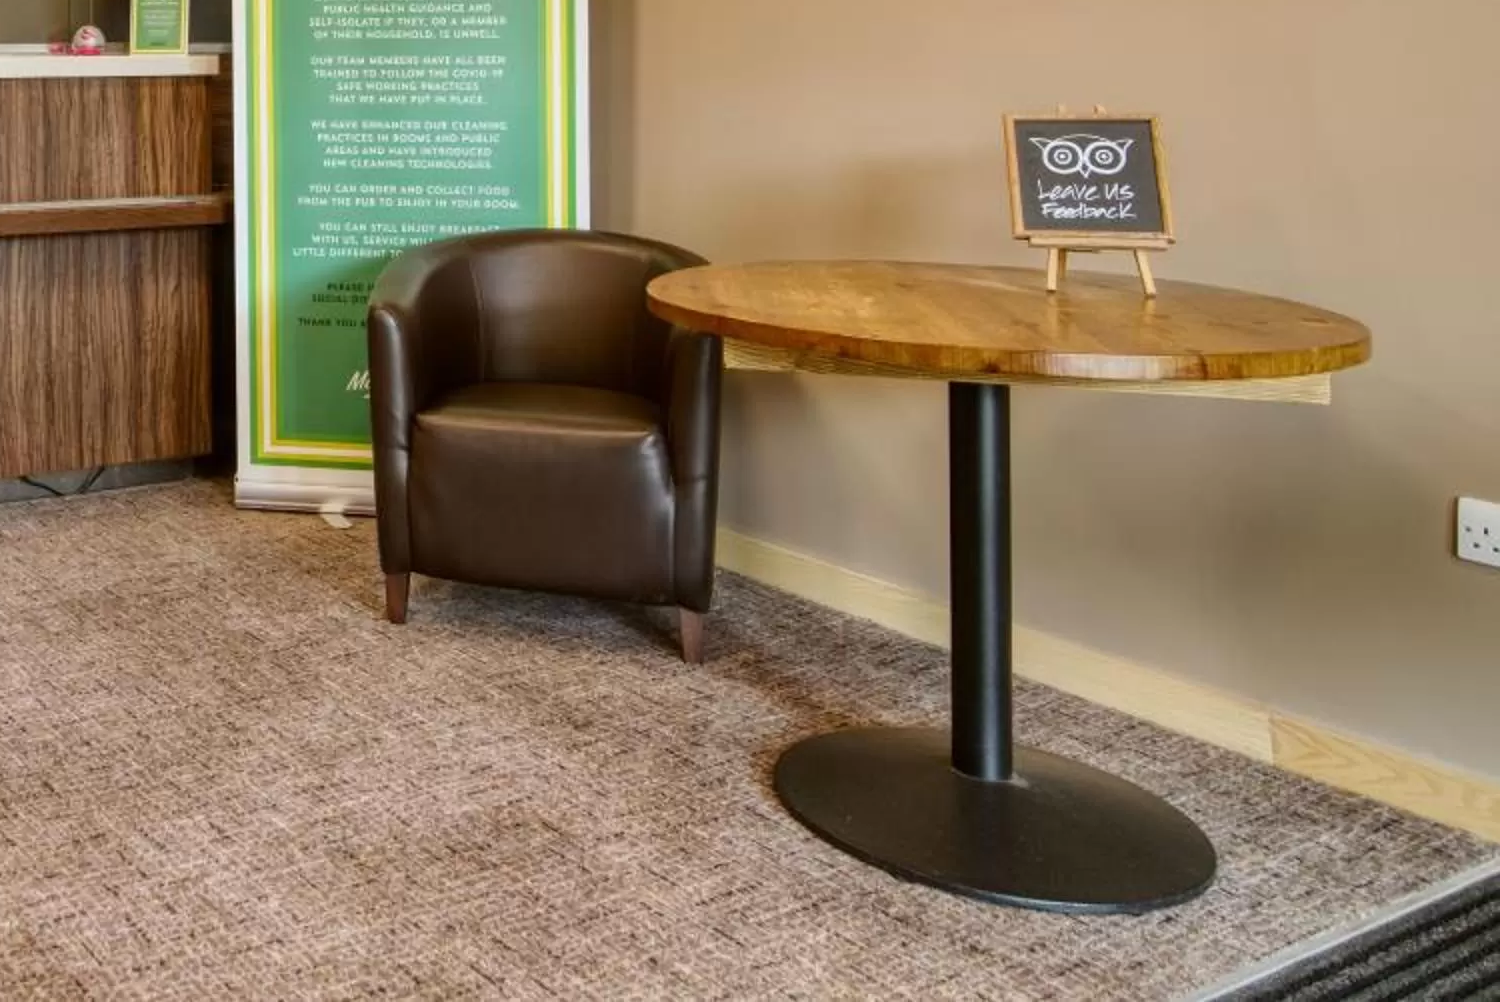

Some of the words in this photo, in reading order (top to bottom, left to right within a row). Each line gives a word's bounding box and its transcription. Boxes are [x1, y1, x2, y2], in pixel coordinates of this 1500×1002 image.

[323, 4, 360, 14] PUBLIC
[363, 4, 405, 14] HEALTH
[408, 3, 465, 13] GUIDANCE
[468, 3, 492, 12] AND
[309, 17, 381, 27] SELF-ISOLATE
[310, 56, 333, 66] OUR
[337, 55, 365, 65] TEAM
[369, 55, 419, 66] MEMBERS
[314, 69, 359, 79] TRAINED
[380, 68, 425, 79] FOLLOW
[336, 82, 363, 91] SAFE
[366, 81, 417, 91] WORKING
[420, 81, 479, 92] PRACTICES
[317, 133, 373, 143] PRACTICES
[325, 146, 359, 156] AREAS
[362, 146, 384, 155] AND
[419, 146, 493, 157] INTRODUCED
[351, 159, 404, 169] CLEANING
[309, 184, 331, 194] YOU
[335, 184, 357, 194] CAN
[360, 184, 397, 194] ORDER
[399, 185, 423, 195] AND
[427, 185, 473, 195] COLLECT
[478, 185, 510, 196] FOOD
[1037, 178, 1101, 201] Leave
[298, 197, 327, 207] FROM
[330, 197, 351, 207] THE
[355, 197, 376, 207] PUB
[379, 197, 394, 207] TO
[397, 198, 431, 208] ENJOY
[435, 198, 447, 208] IN
[451, 198, 481, 209] YOUR
[319, 222, 341, 231] YOU
[344, 222, 367, 231] CAN
[371, 223, 398, 233] STILL
[401, 223, 436, 234] ENJOY
[312, 235, 338, 245] WITH
[363, 236, 405, 247] SERVICE
[330, 248, 386, 259] DIFFERENT
